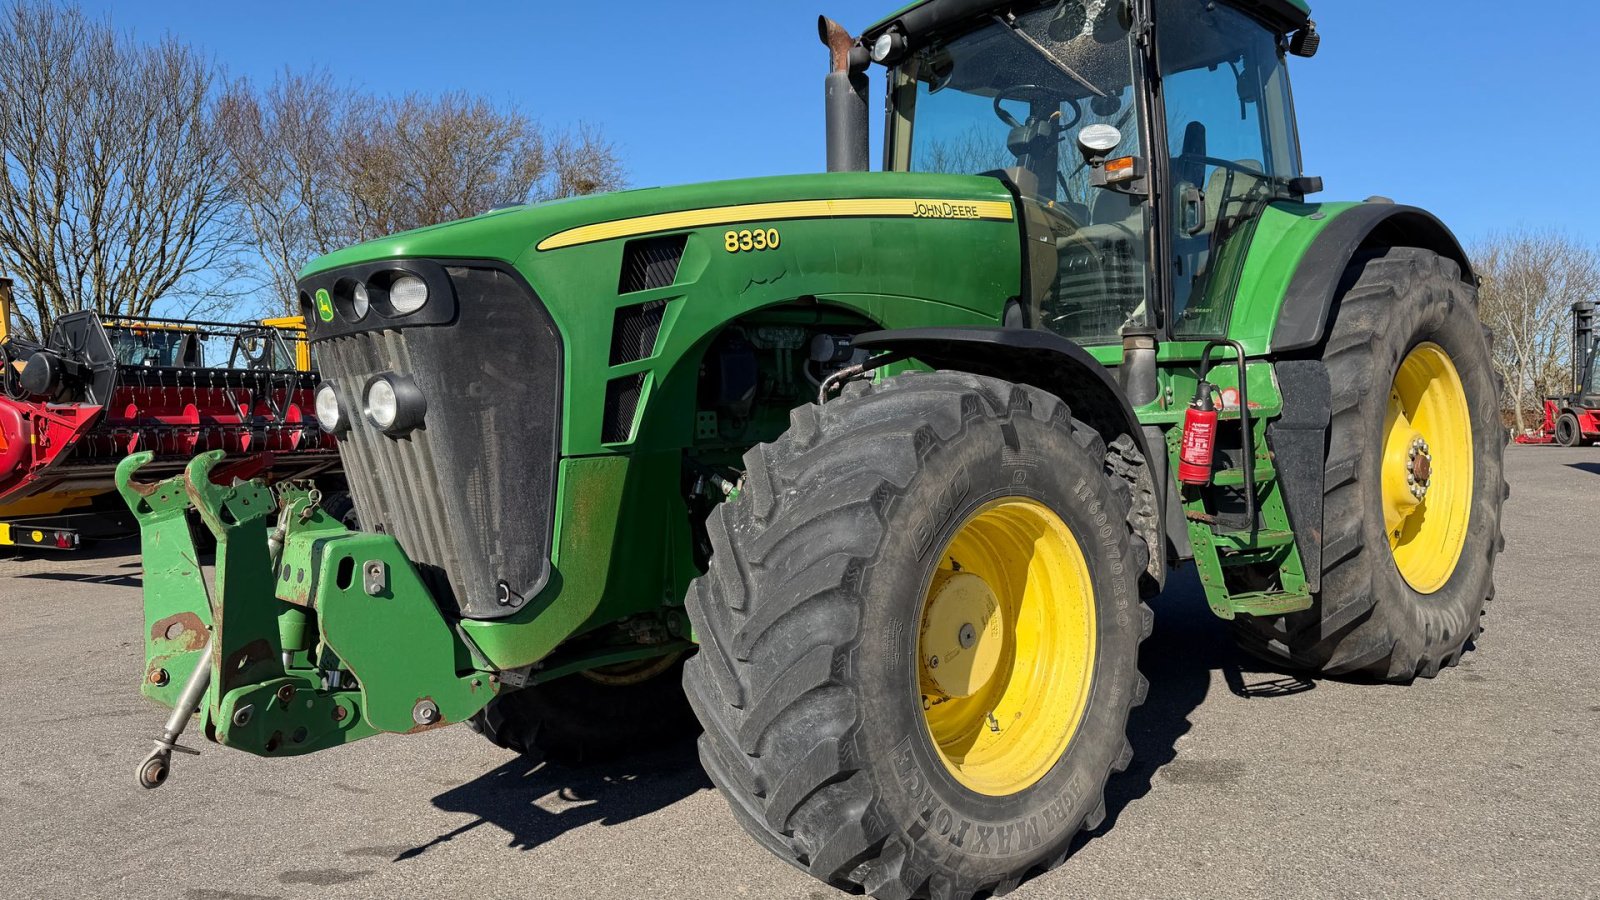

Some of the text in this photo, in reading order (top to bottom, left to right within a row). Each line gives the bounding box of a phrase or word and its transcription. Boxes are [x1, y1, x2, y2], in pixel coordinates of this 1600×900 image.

[913, 201, 979, 217] JOHN DEERE
[724, 228, 781, 253] 8330
